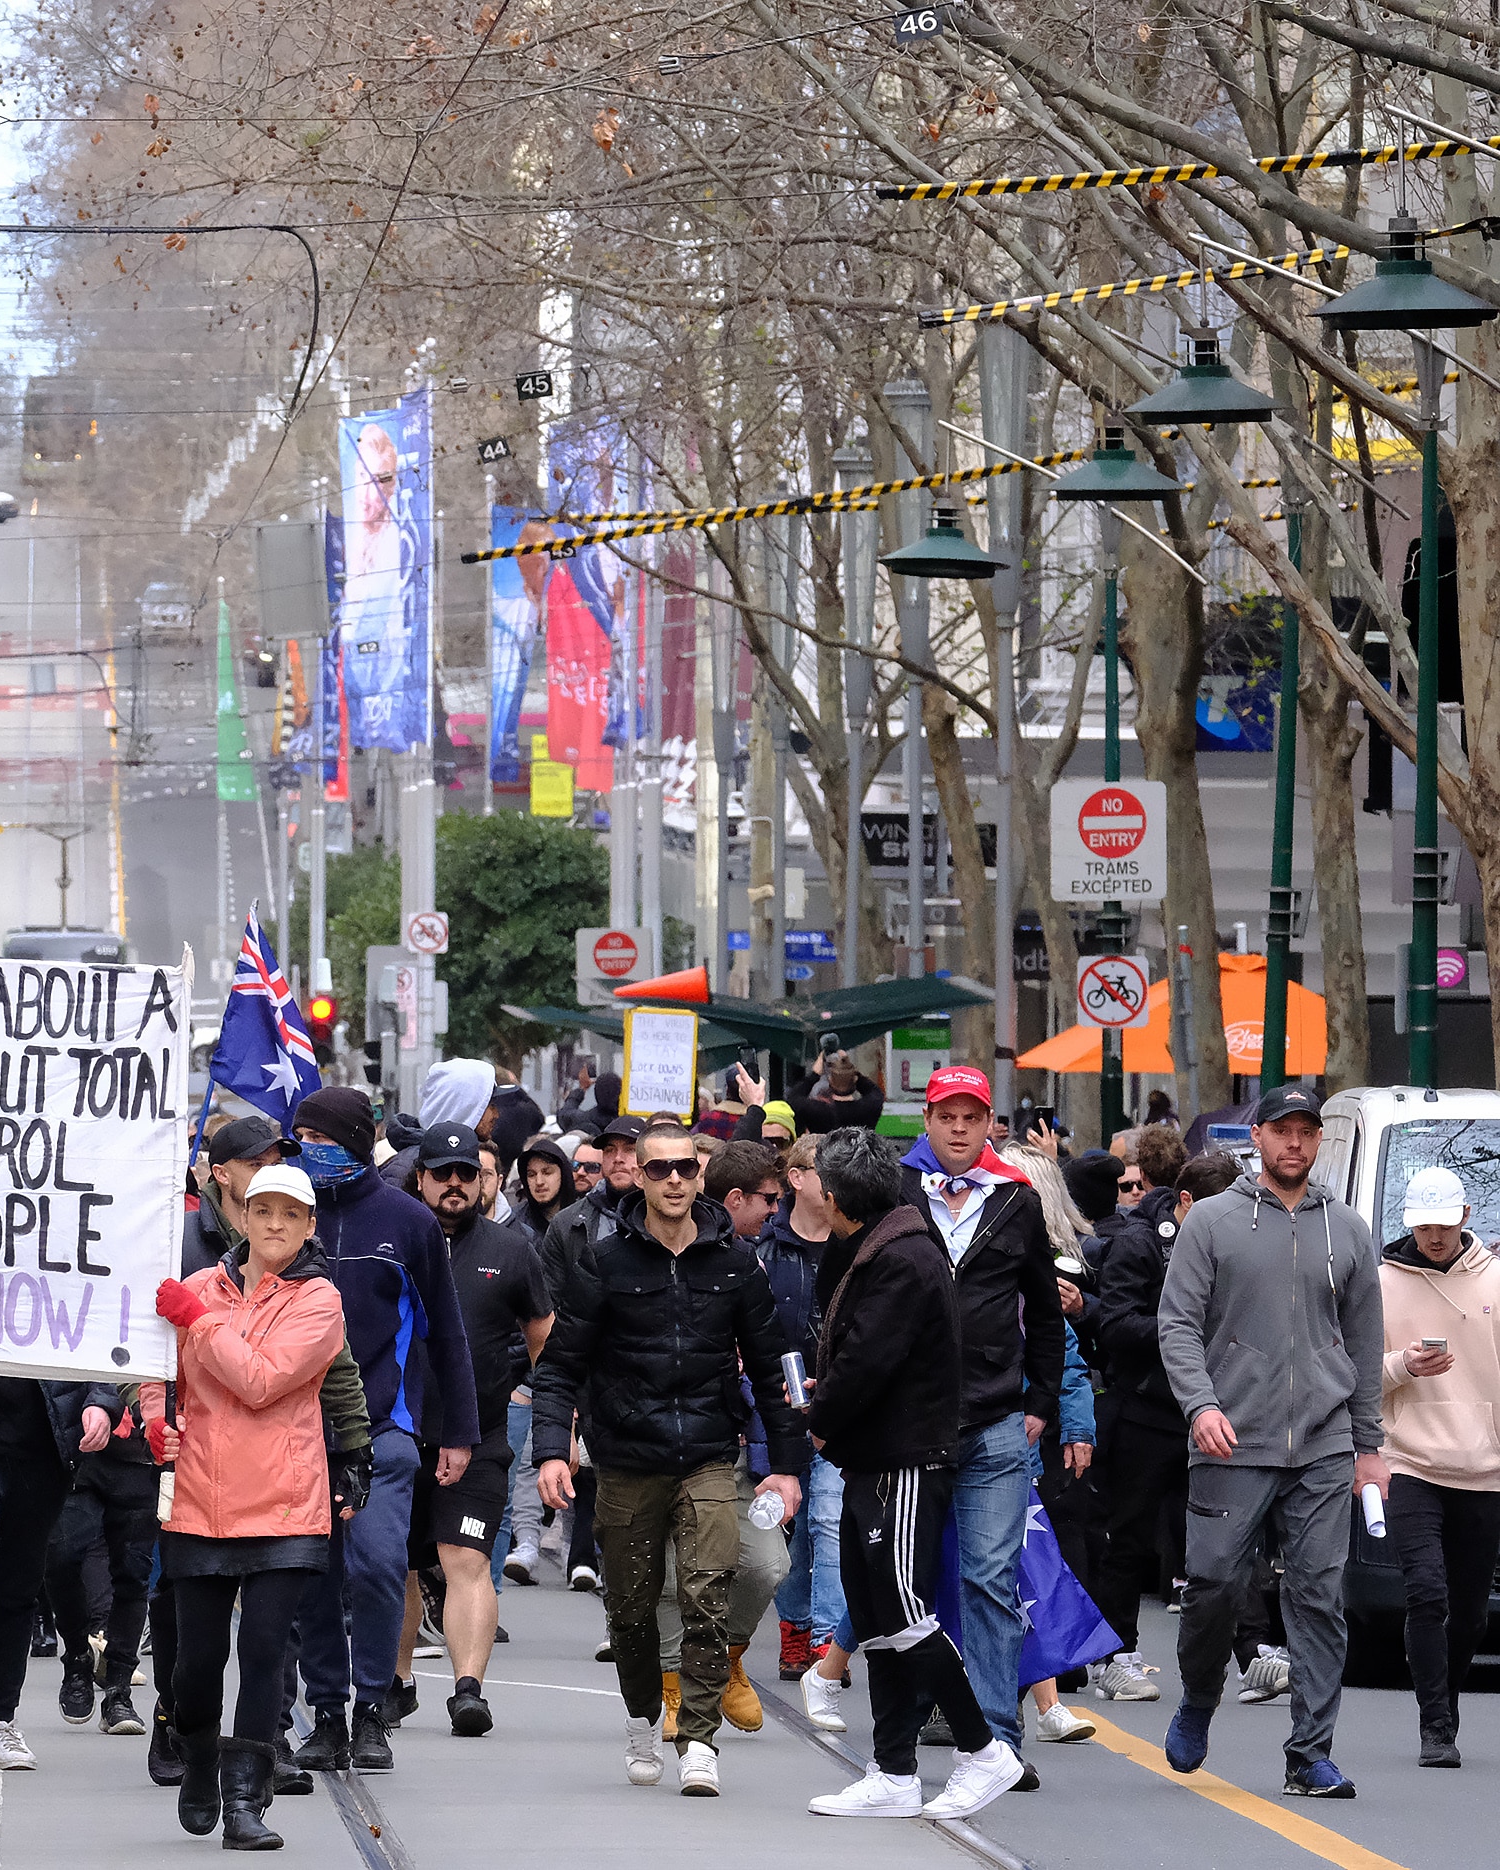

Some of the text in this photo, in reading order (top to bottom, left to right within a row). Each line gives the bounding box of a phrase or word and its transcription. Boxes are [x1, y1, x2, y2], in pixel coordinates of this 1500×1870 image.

[901, 10, 938, 35] 46
[521, 375, 550, 394] 45
[483, 441, 507, 461] 44
[359, 643, 378, 653] 42
[1102, 798, 1123, 813] NO
[1089, 832, 1138, 848] ENTRY
[1085, 861, 1139, 876] TRAMS
[1071, 879, 1153, 894] EXCEPTED
[135, 969, 178, 1040] A
[67, 1047, 176, 1121] TOTAL
[629, 1085, 692, 1107] SUSTAINABLE
[460, 1515, 486, 1540] NBL
